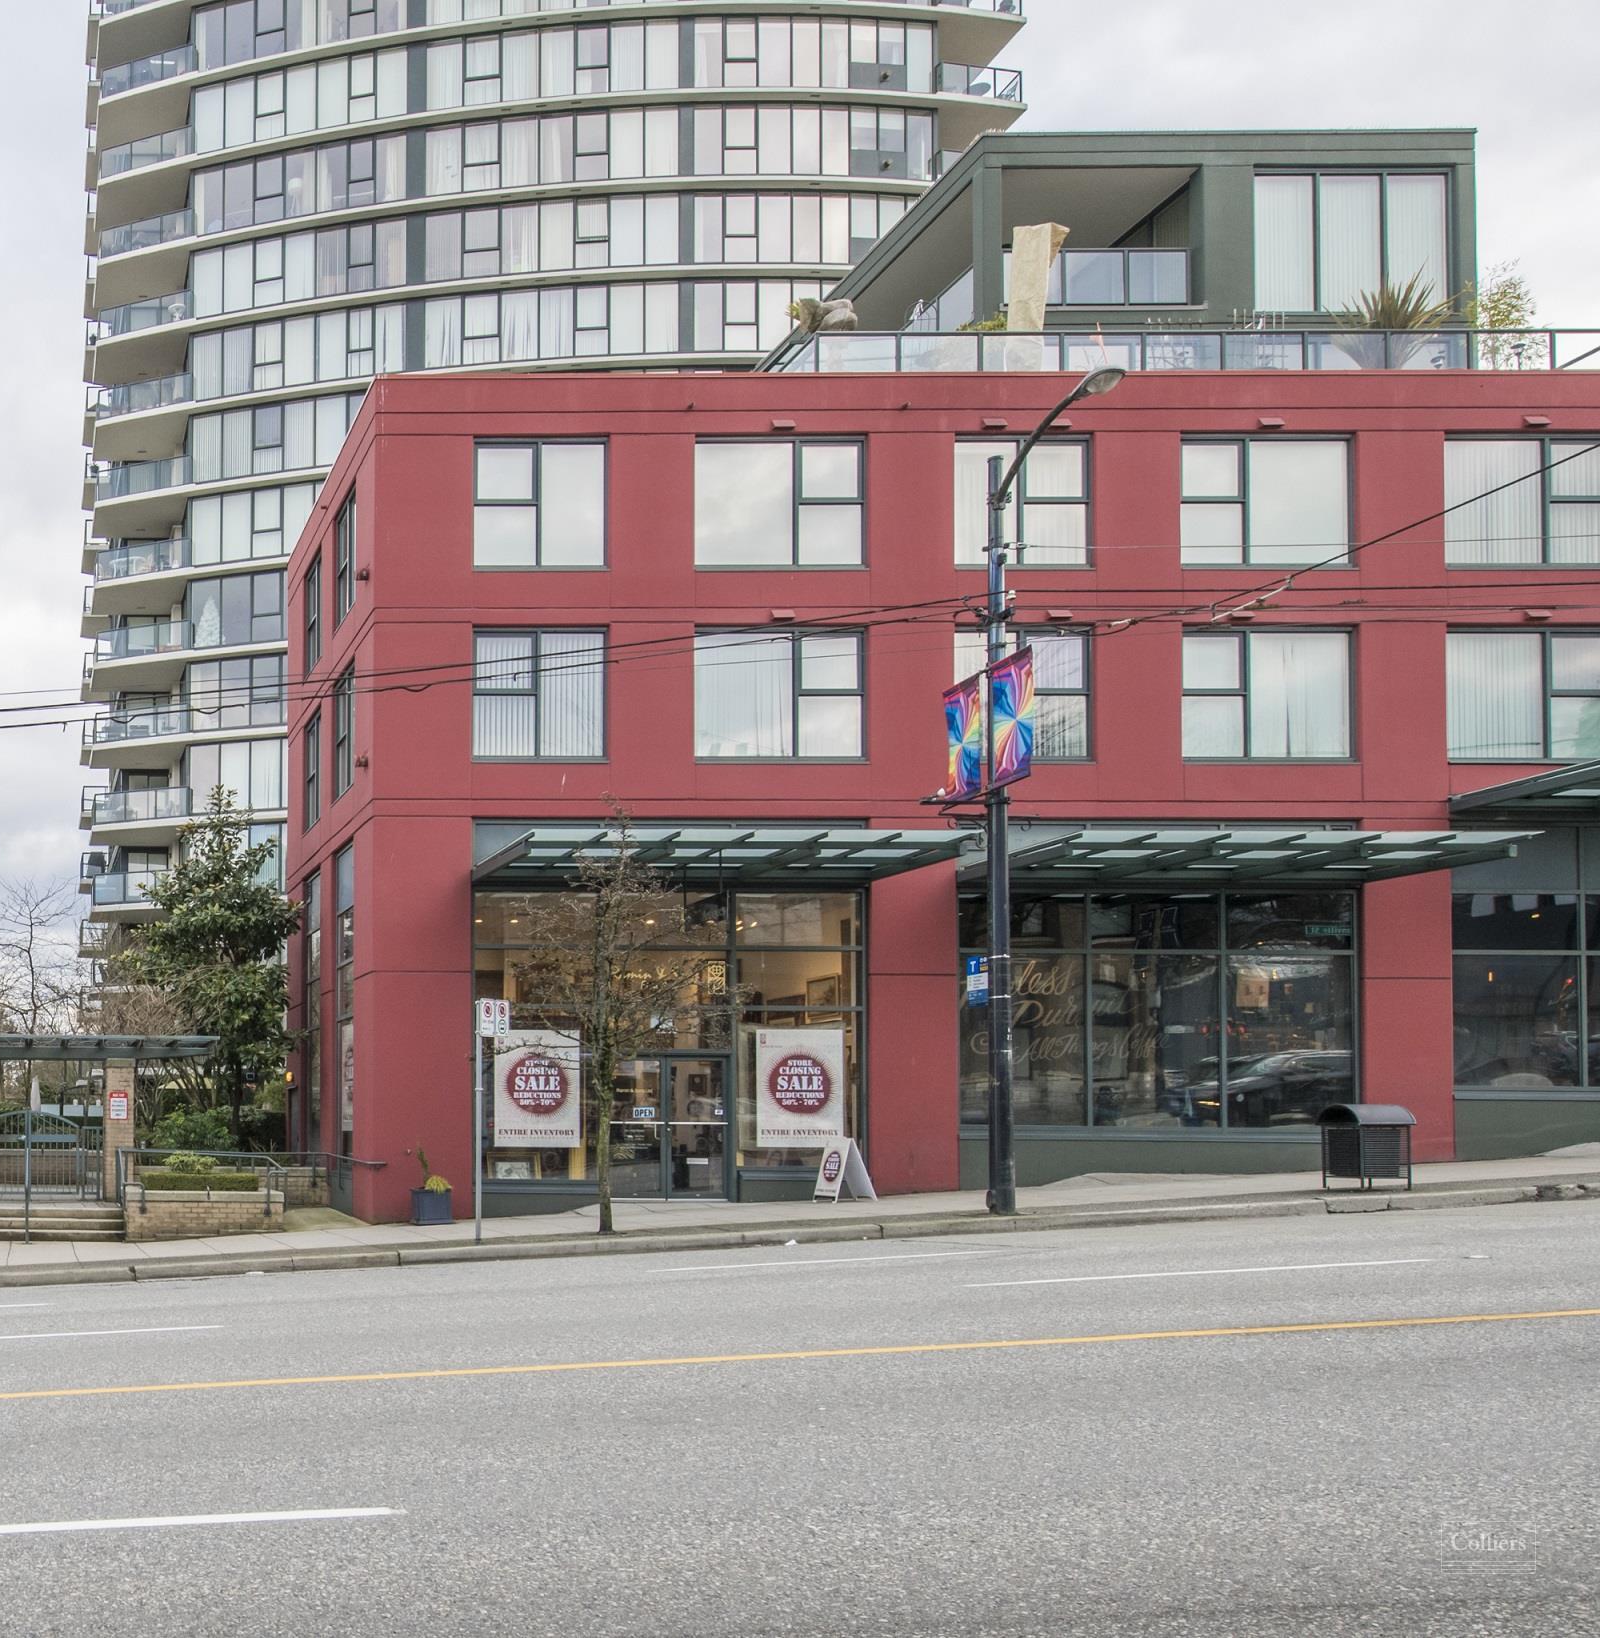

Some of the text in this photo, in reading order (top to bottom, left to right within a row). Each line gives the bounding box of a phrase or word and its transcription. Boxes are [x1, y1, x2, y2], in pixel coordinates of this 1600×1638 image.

[970, 961, 977, 973] T
[516, 1067, 558, 1075] CLOSING
[779, 1067, 821, 1075] CLOSING
[514, 1076, 560, 1091] SALE
[777, 1076, 824, 1091] SALE
[634, 1108, 653, 1117] OPEN
[530, 1129, 575, 1137] INVENTORY
[792, 1129, 839, 1137] INVENTORY
